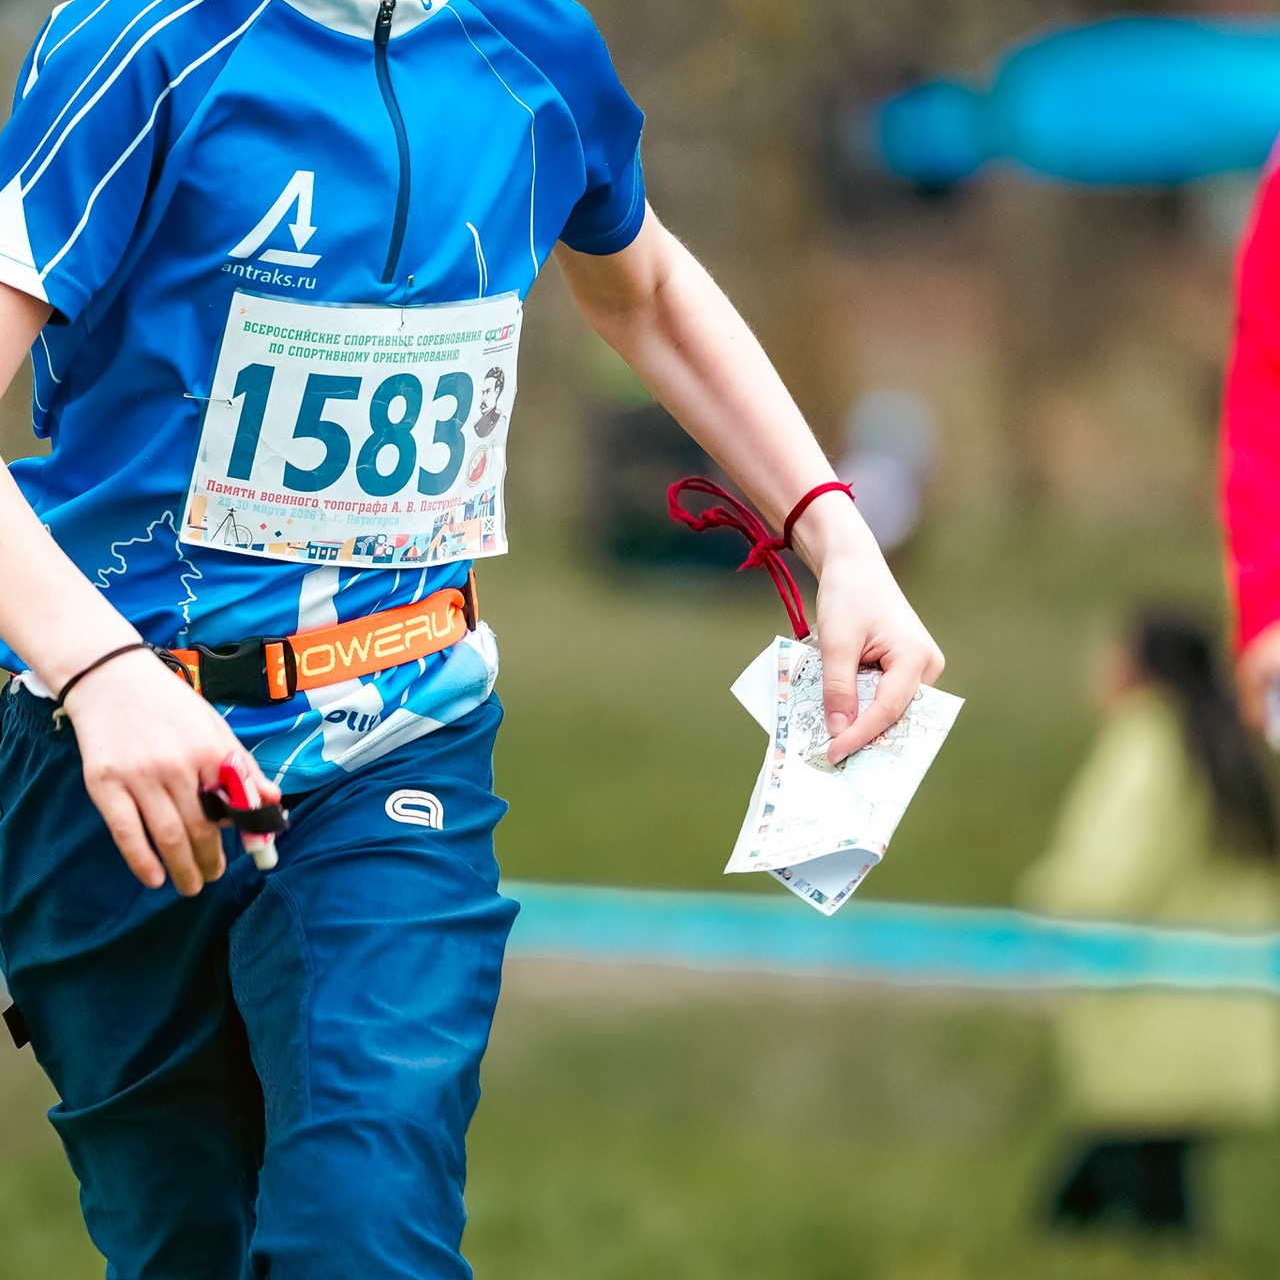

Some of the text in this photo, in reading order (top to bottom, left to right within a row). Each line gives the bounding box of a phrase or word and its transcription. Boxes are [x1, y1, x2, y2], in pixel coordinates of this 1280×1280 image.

[221, 263, 317, 289] antraks.ru
[243, 321, 341, 345] ВСЕРОССИЙСКИЕ
[344, 334, 413, 347] СПОРТИВНЫЕ
[417, 330, 482, 347] СОРЕВНОВАНИЯ
[268, 342, 460, 363] ПО СПОРТИВНОМУ ОРИЕНТИРОВАНИЮ
[226, 362, 474, 497] 1583
[206, 479, 256, 499] Памяти
[260, 491, 319, 508] военного
[324, 499, 388, 515] топографа
[391, 501, 402, 512] А.
[406, 501, 416, 513] В.
[252, 503, 286, 517] марта
[290, 508, 316, 520] 2026
[346, 514, 400, 527] Пятигорск
